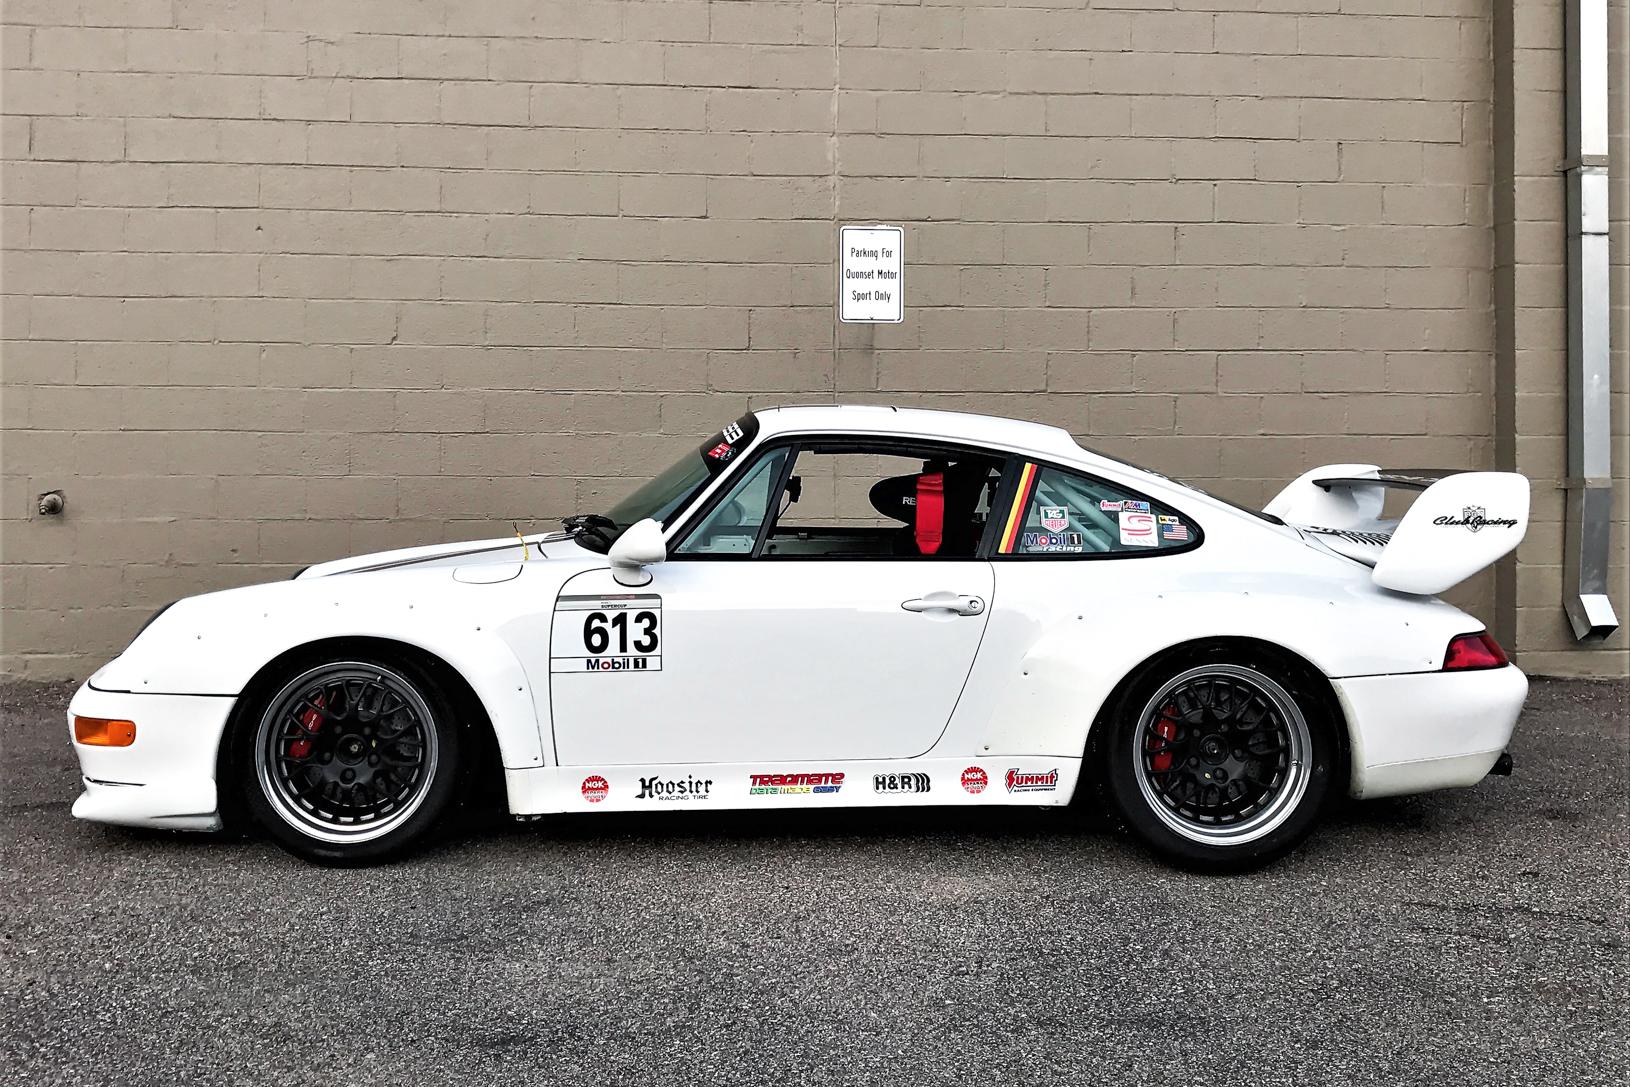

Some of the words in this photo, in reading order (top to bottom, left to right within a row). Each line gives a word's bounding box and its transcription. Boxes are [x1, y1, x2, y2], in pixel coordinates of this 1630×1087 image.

[850, 247, 878, 261] Parking
[881, 247, 893, 258] For
[845, 268, 875, 279] Quonset
[877, 269, 898, 279] Motor
[852, 290, 872, 302] Sport
[874, 290, 891, 303] Only
[902, 496, 917, 506] RE
[1046, 509, 1063, 519] TAG
[1471, 515, 1518, 529] Racing
[1024, 533, 1067, 547] Mobil
[1069, 533, 1083, 546] 1
[1042, 546, 1083, 554] racing
[583, 611, 659, 654] 613
[586, 658, 630, 670] Mobil
[633, 658, 647, 669] 1
[964, 771, 984, 780] NGK
[585, 781, 605, 789] NGK
[635, 774, 713, 799] Hoosier
[874, 774, 915, 791] H&R
